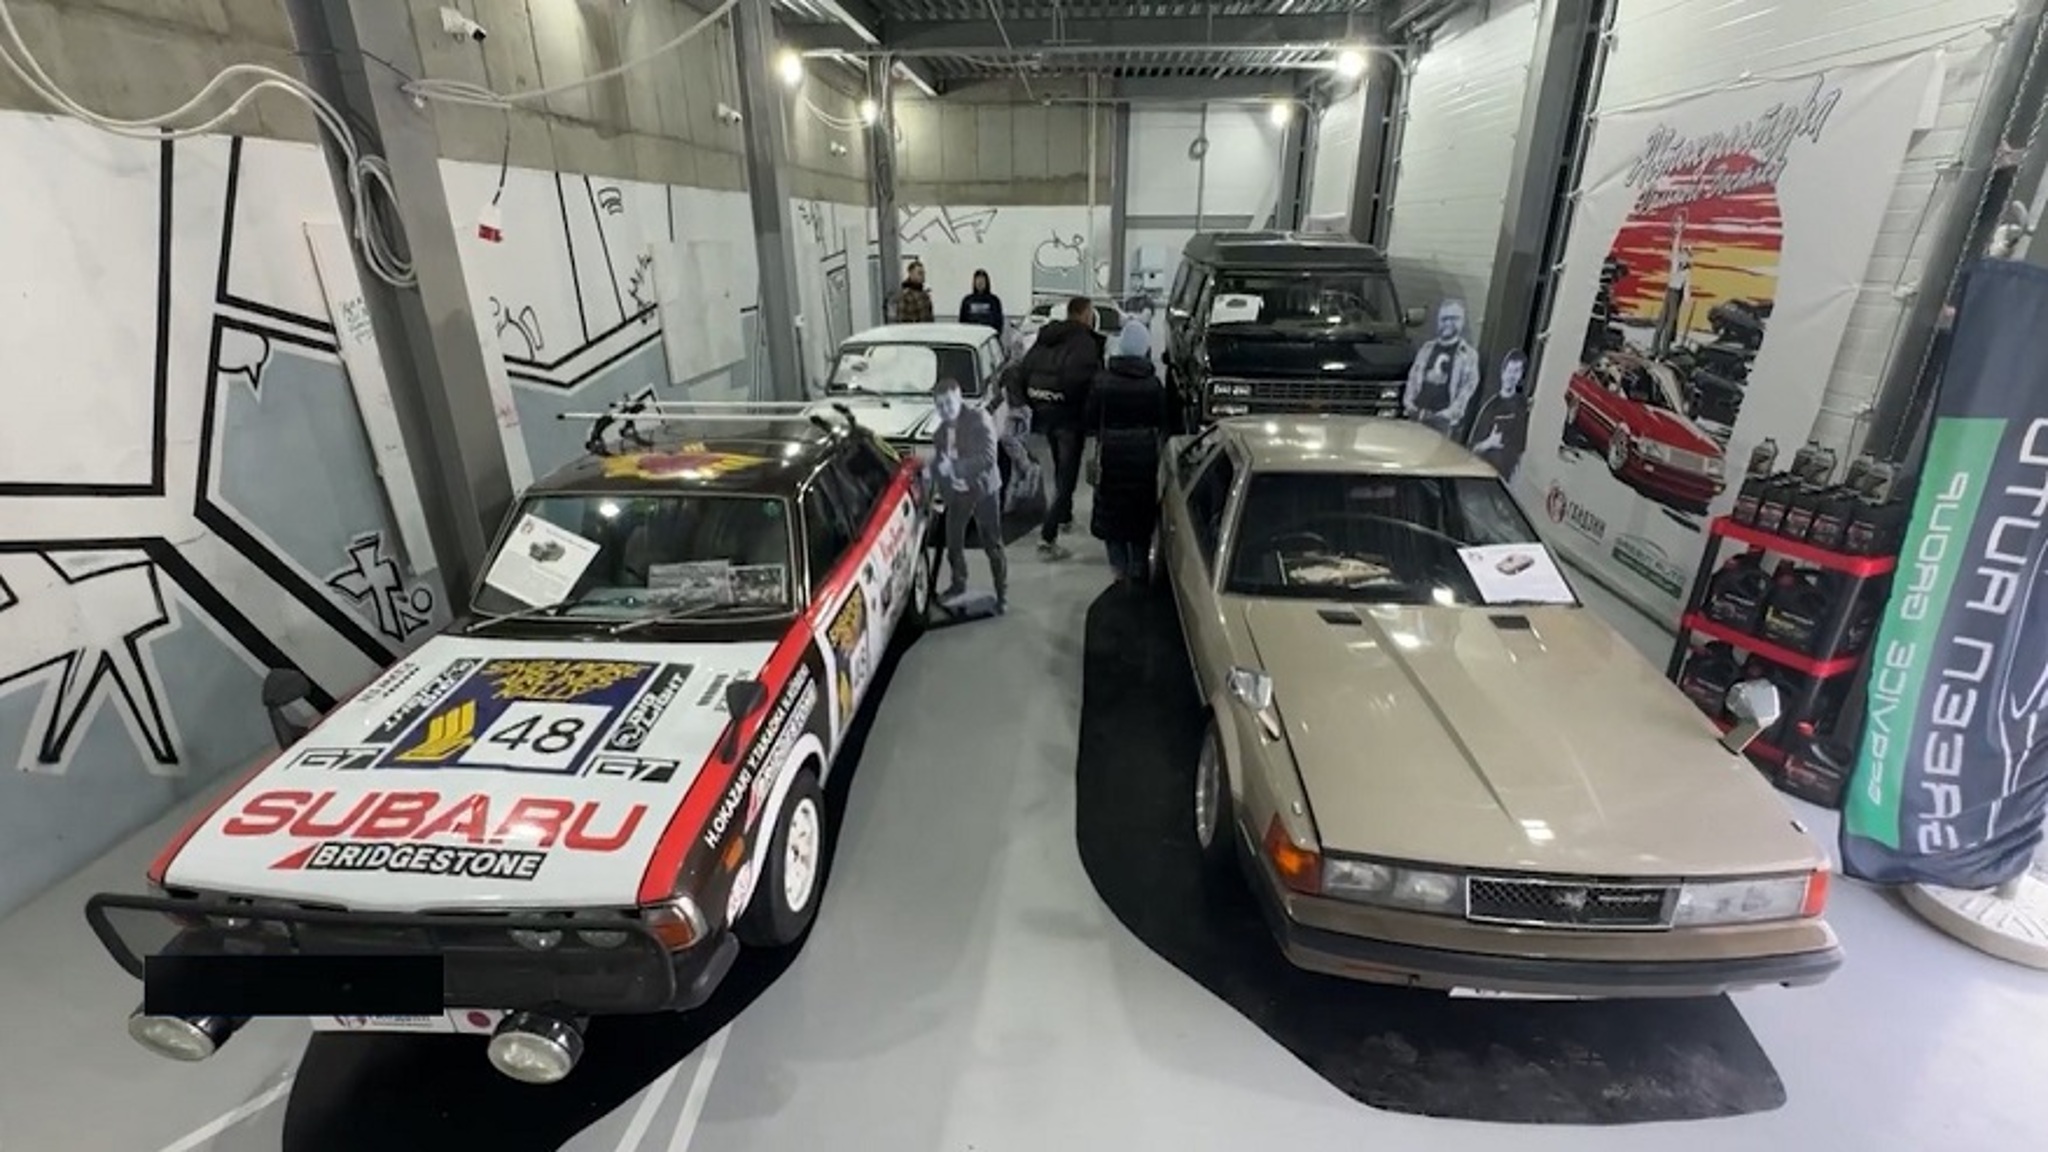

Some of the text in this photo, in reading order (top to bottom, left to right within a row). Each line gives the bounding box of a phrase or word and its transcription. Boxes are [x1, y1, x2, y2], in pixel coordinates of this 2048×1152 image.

[489, 714, 585, 754] 48
[285, 747, 385, 770] GT
[583, 756, 680, 783] GT
[222, 790, 648, 853] SUBARU
[704, 769, 752, 849] H.OKAZAKI
[312, 843, 546, 880] BRIDGESTONE
